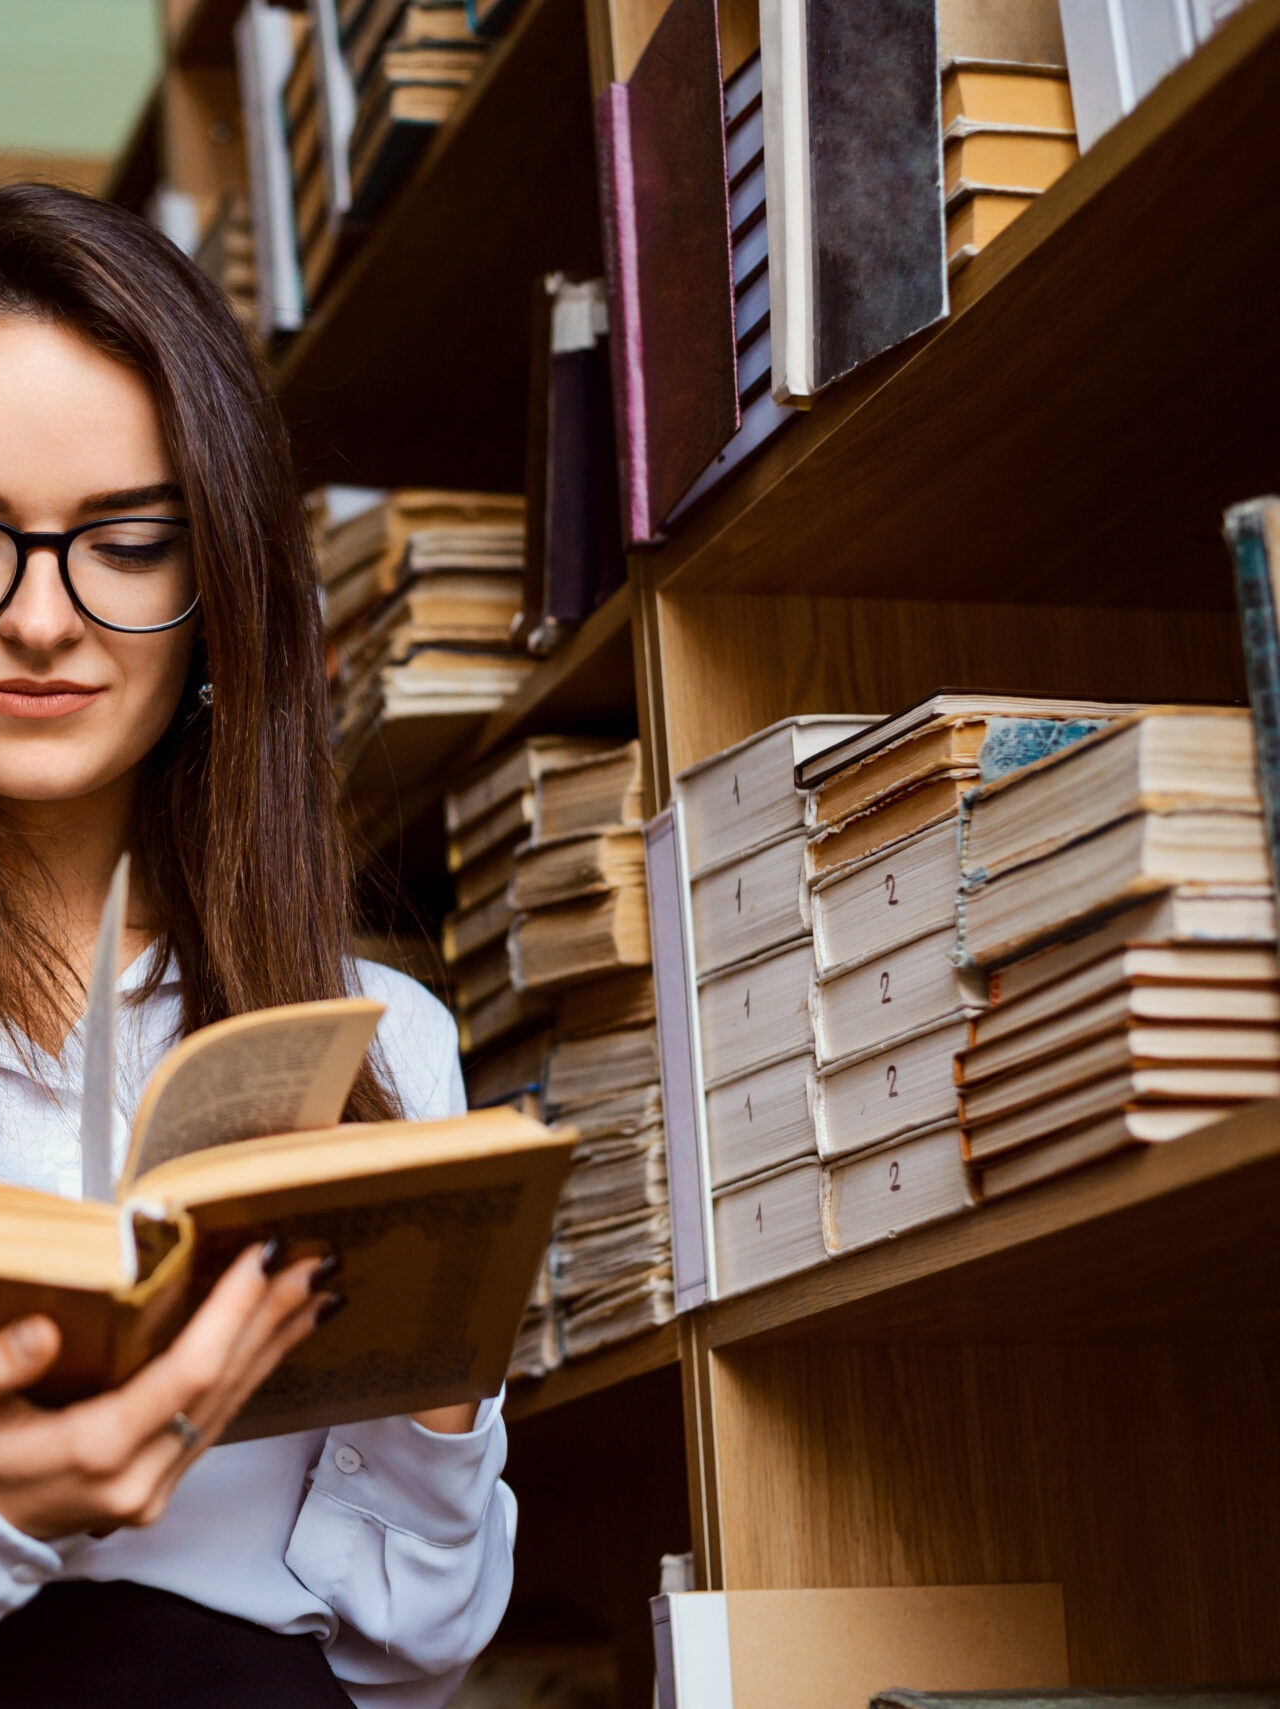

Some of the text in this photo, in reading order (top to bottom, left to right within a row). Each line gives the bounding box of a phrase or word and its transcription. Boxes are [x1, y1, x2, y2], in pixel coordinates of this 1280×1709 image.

[732, 774, 740, 806] 1
[734, 877, 742, 914] 1
[885, 873, 899, 906] 2
[743, 988, 751, 1019] 1
[880, 971, 892, 1004] 2
[886, 1064, 899, 1098] 2
[744, 1093, 753, 1122] 1
[889, 1161, 901, 1192] 2
[755, 1202, 763, 1234] 1
